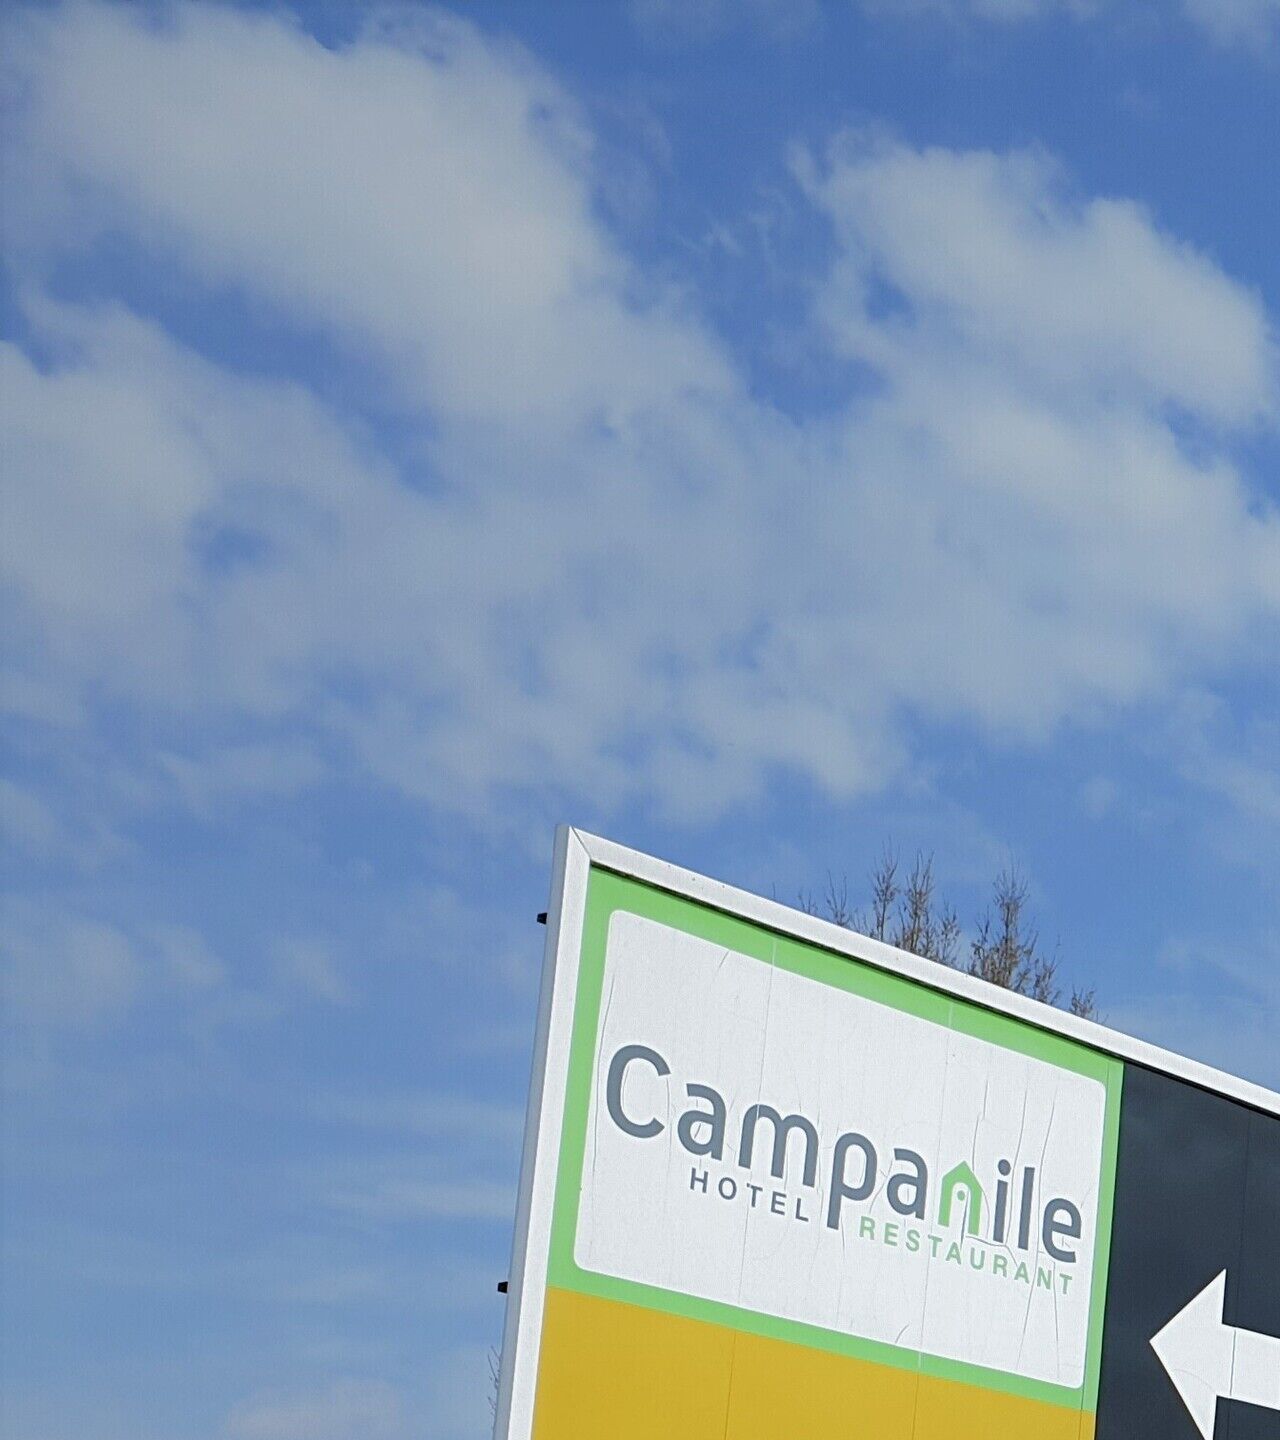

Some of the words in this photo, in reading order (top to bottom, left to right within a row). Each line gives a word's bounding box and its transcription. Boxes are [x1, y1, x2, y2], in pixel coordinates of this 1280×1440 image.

[606, 1044, 1082, 1263] Campanile
[690, 1167, 809, 1222] HOTEL
[859, 1216, 1073, 1294] RESTAURANT
